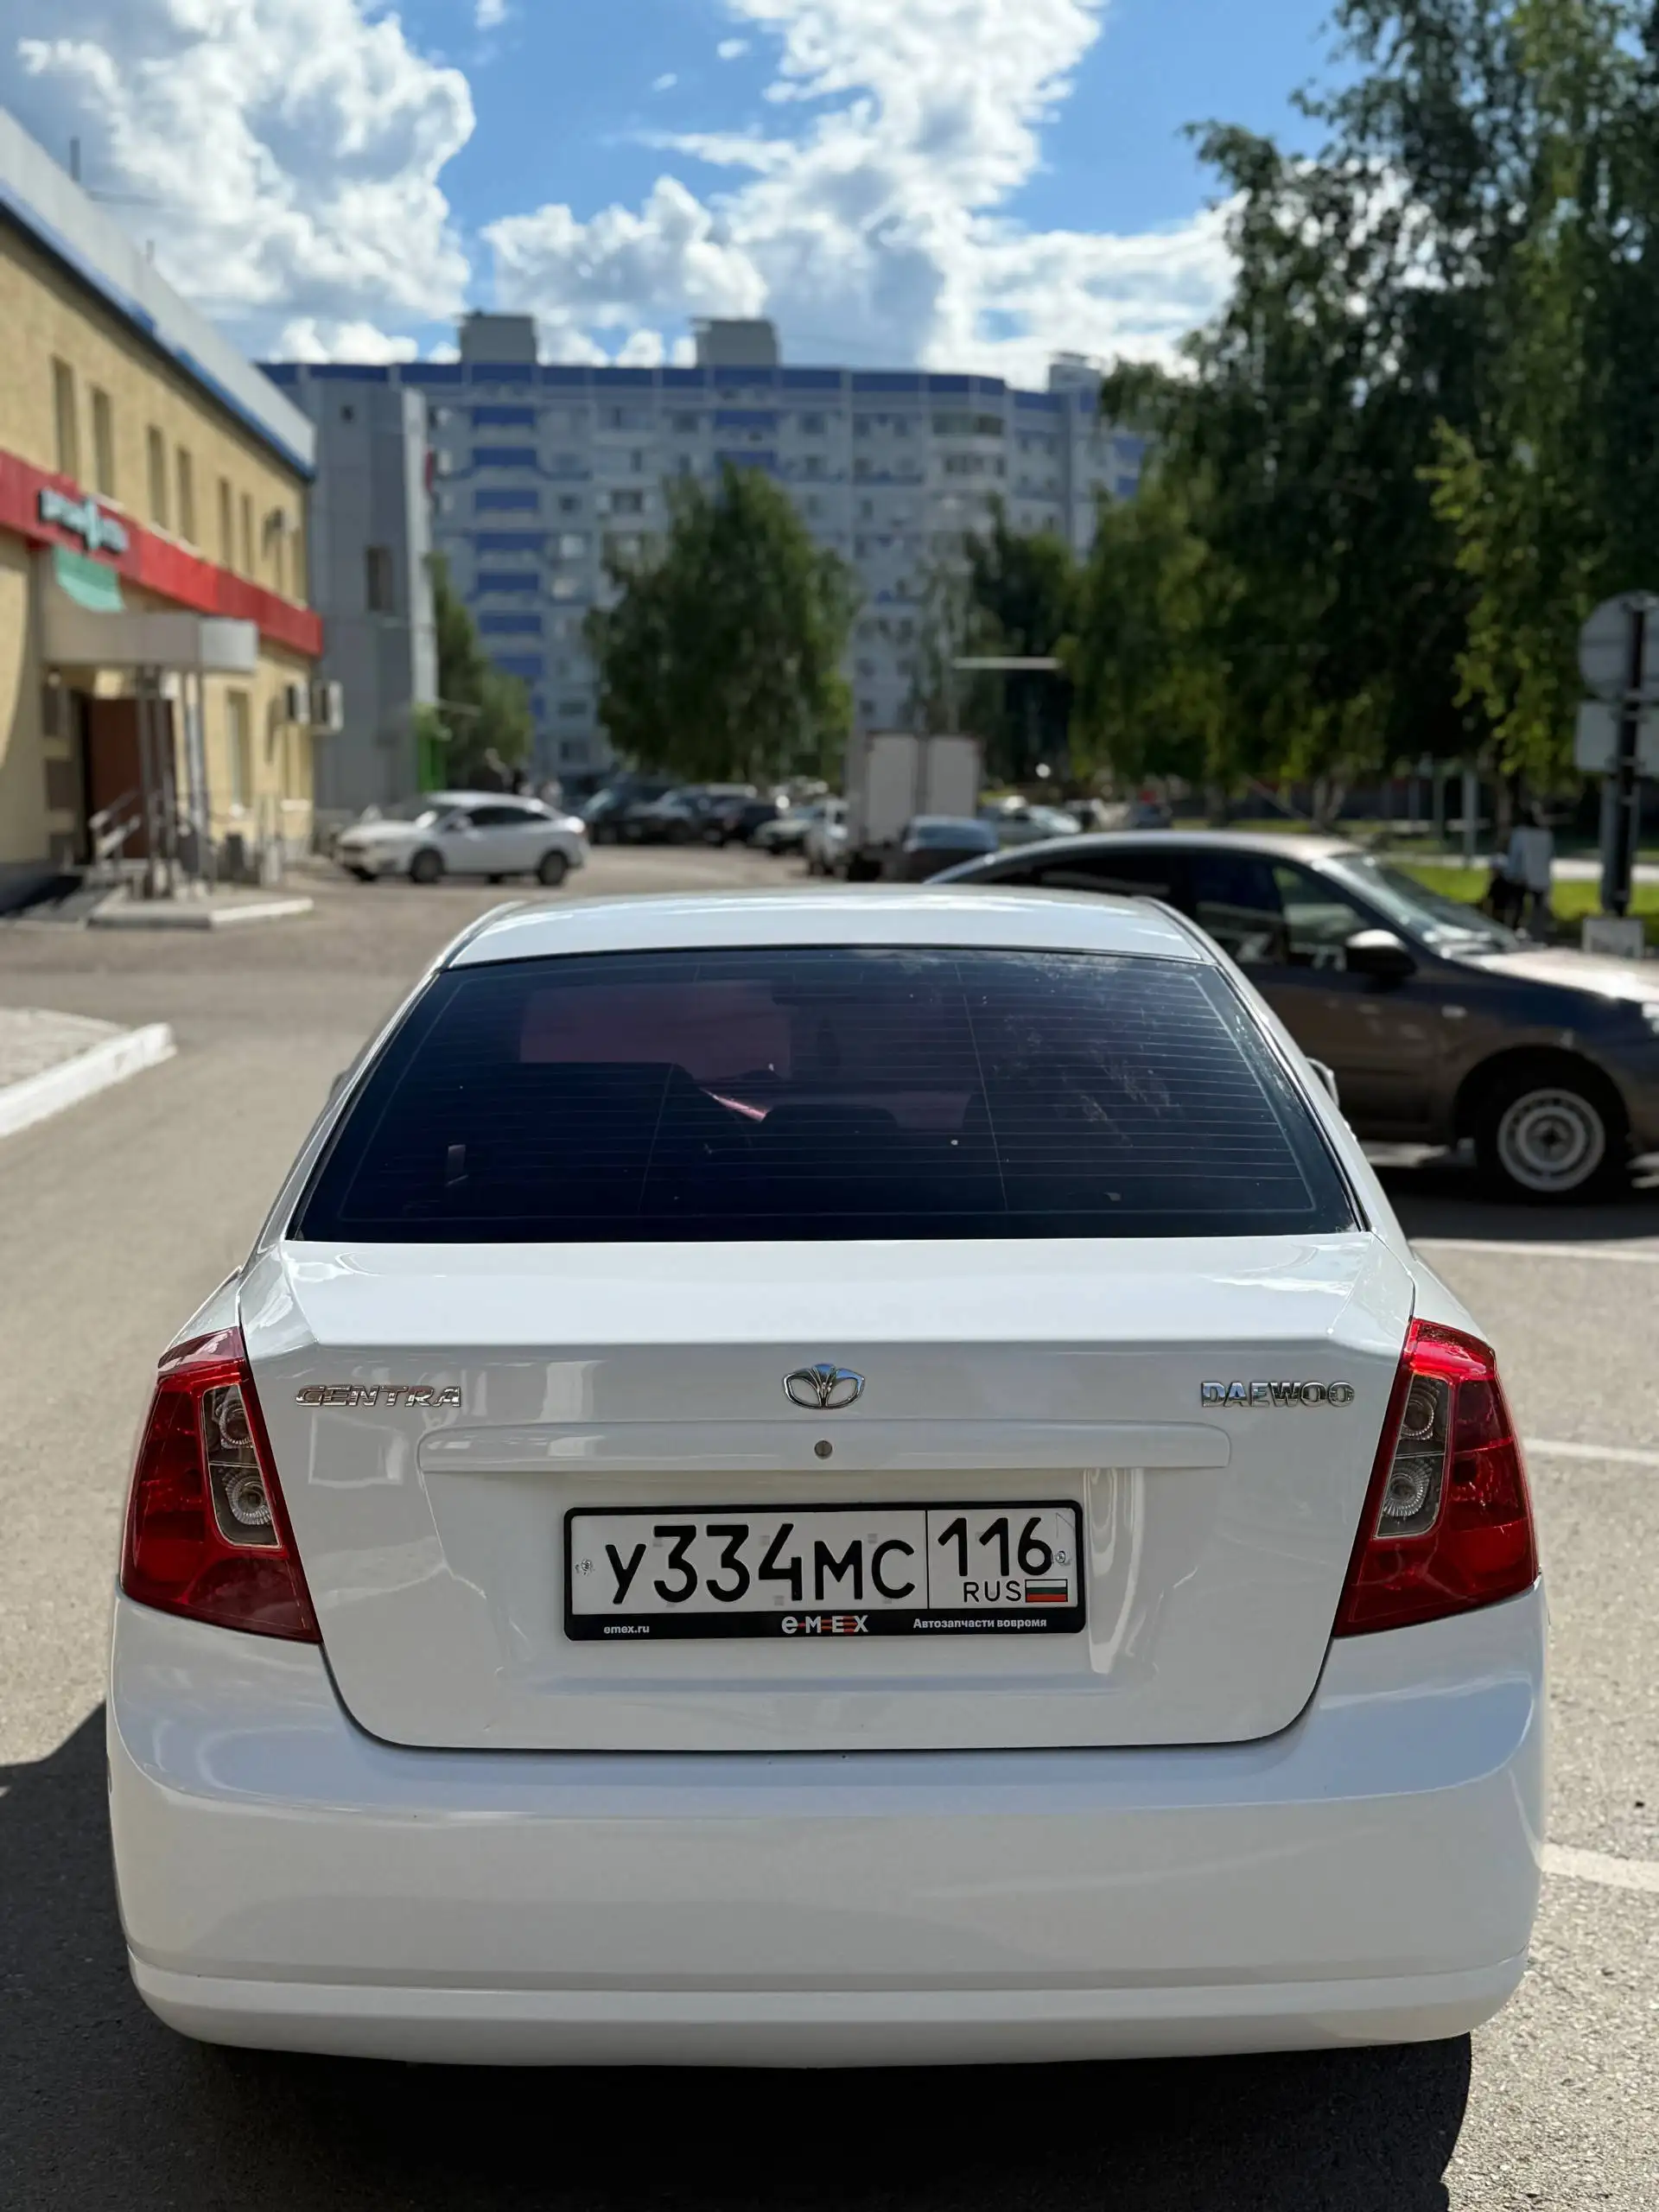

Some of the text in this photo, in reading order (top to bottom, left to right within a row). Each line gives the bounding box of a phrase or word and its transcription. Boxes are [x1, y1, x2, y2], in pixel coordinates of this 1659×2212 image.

[295, 1384, 461, 1407] GENTRA
[1201, 1381, 1355, 1408] DAEWOO
[938, 1517, 1053, 1576] 116
[963, 1580, 1021, 1602] RUS
[603, 1625, 650, 1634] emex.ru
[913, 1618, 1047, 1629] Автозапчасти вовремя
